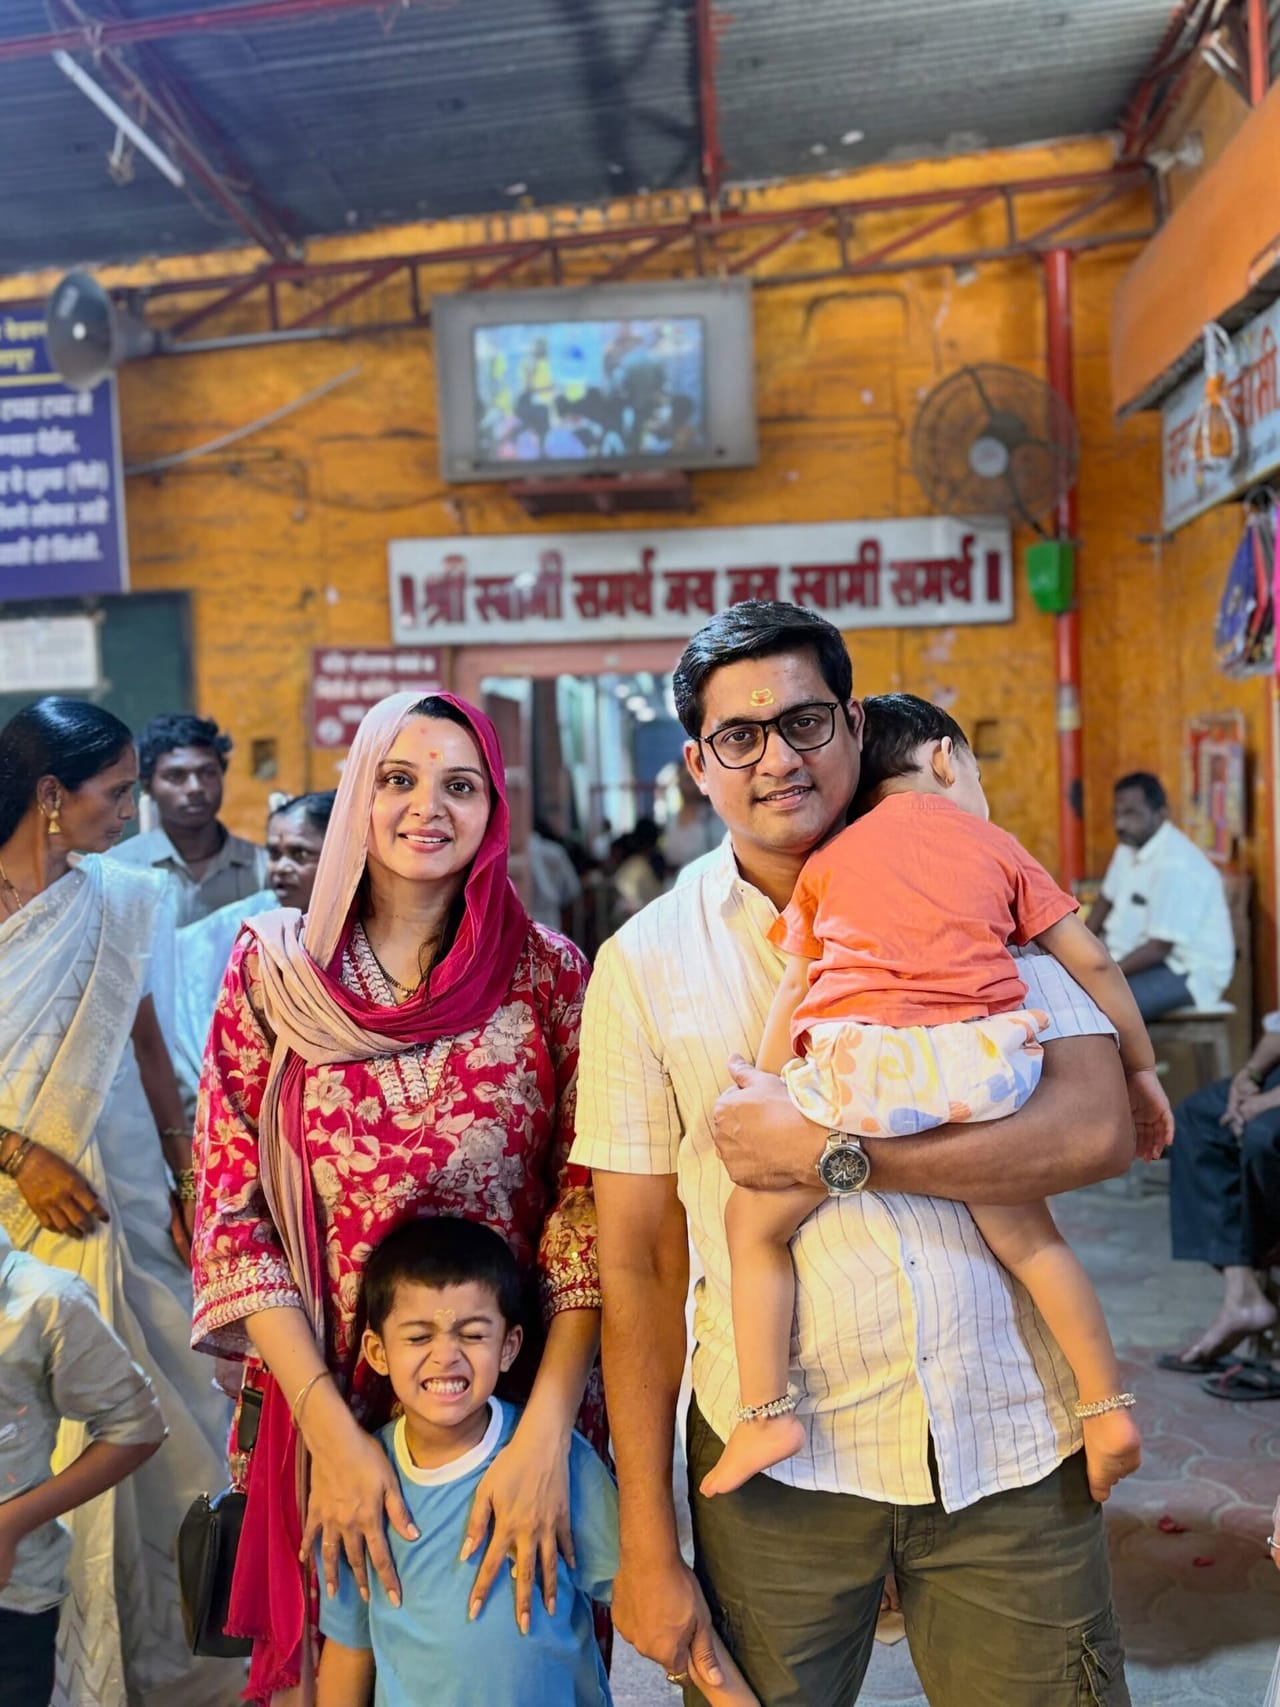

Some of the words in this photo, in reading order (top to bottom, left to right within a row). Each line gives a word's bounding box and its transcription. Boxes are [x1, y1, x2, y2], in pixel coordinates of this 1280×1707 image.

[424, 554, 466, 625] श्री
[475, 550, 563, 622] स्वामी
[572, 548, 655, 619] समर्थ
[663, 570, 717, 616] जय
[790, 538, 881, 609] स्वामी
[889, 534, 975, 606] समर्थ
